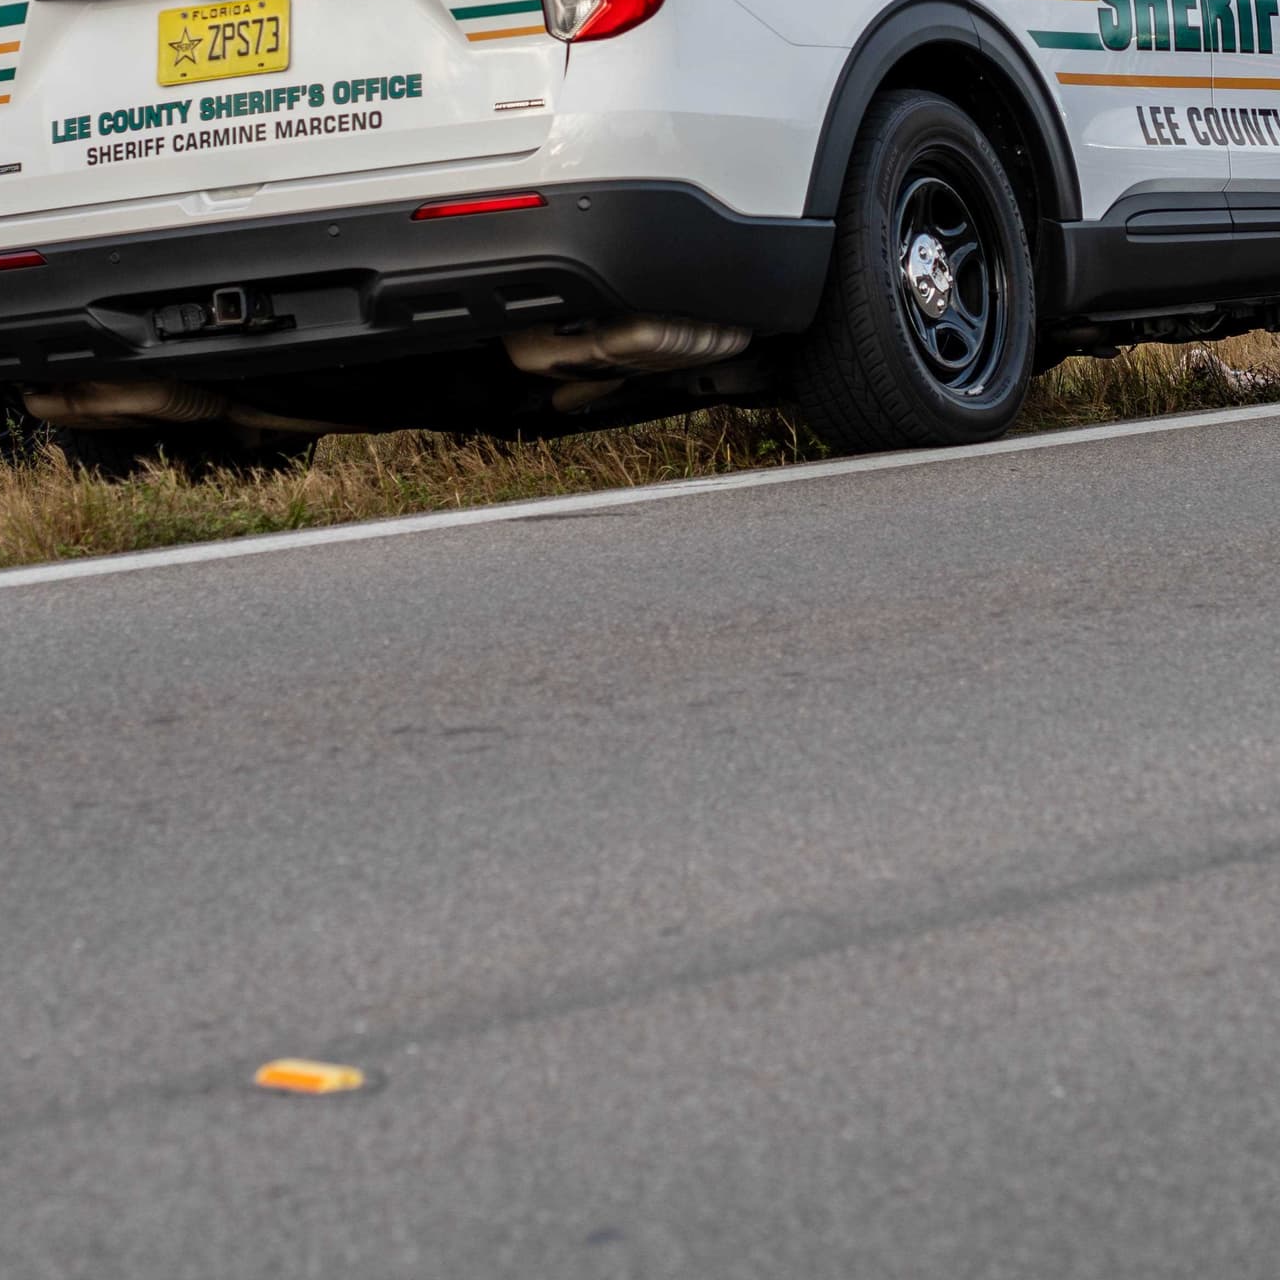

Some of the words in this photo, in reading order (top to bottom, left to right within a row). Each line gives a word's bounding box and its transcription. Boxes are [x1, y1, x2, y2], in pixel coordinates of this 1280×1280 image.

[191, 4, 252, 21] FLORIDA
[207, 16, 280, 61] ZPS73
[51, 115, 91, 144] LEE
[98, 99, 193, 136] COUNTY
[200, 84, 324, 121] SHERIFF'S
[332, 73, 423, 104] OFFICE
[1136, 105, 1187, 146] LEE
[86, 137, 166, 166] SHERIFF
[172, 123, 267, 153] CARMINE
[275, 111, 383, 140] MARCENO
